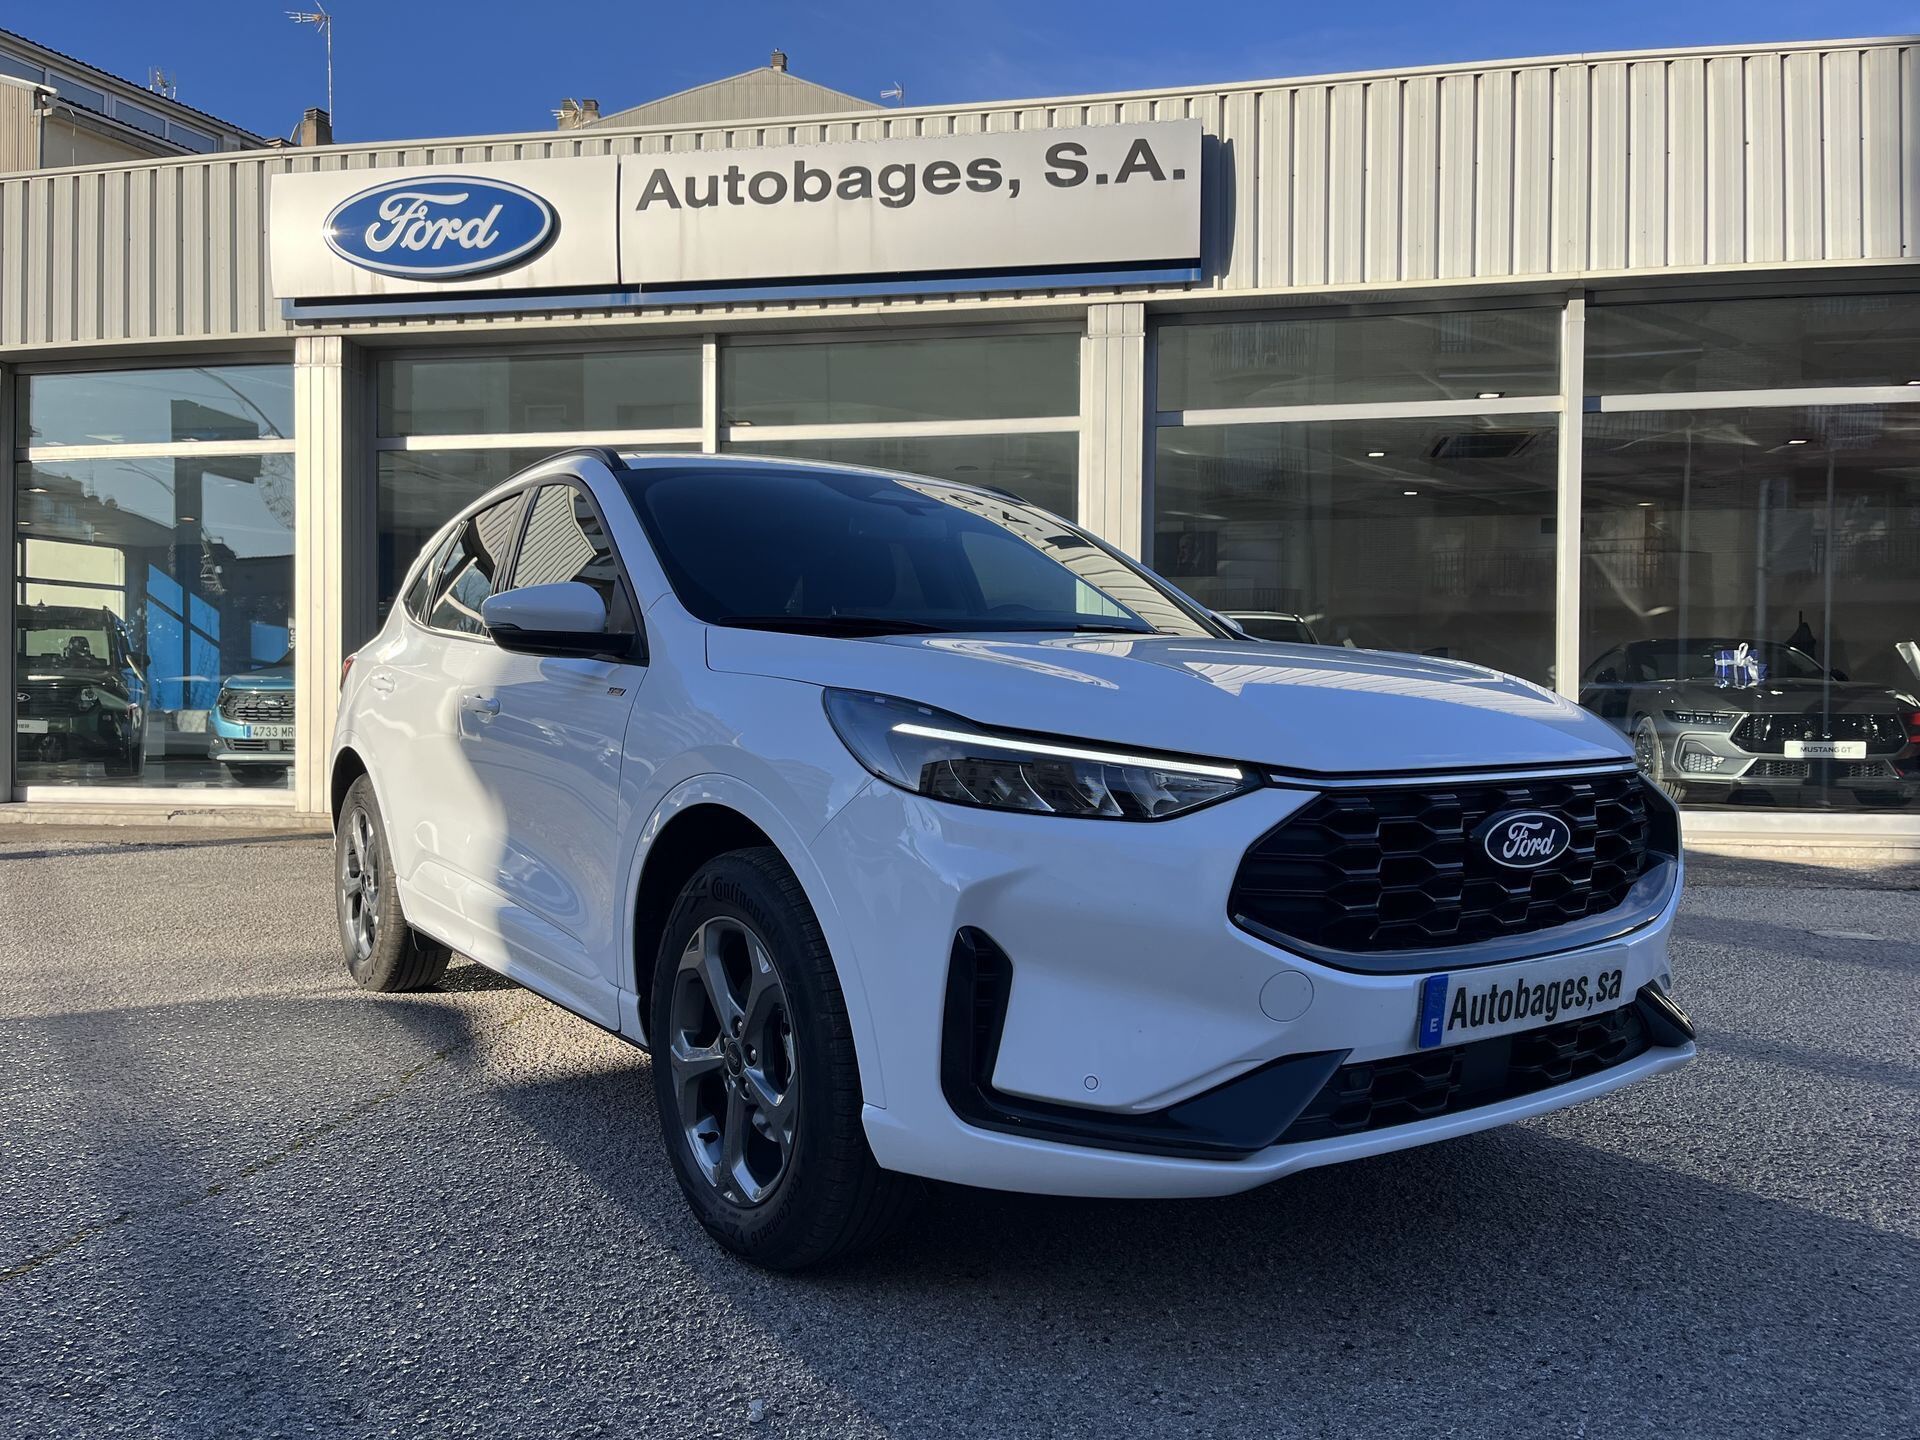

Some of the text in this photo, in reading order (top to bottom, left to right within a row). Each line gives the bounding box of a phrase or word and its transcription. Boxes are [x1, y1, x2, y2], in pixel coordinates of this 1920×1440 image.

[636, 138, 1187, 208] Autobages, S.A.
[365, 193, 503, 252] Ford
[253, 726, 278, 737] 4733
[1503, 822, 1556, 859] Ford
[1447, 969, 1623, 1031] Autobages,sa
[1429, 1018, 1439, 1032] E
